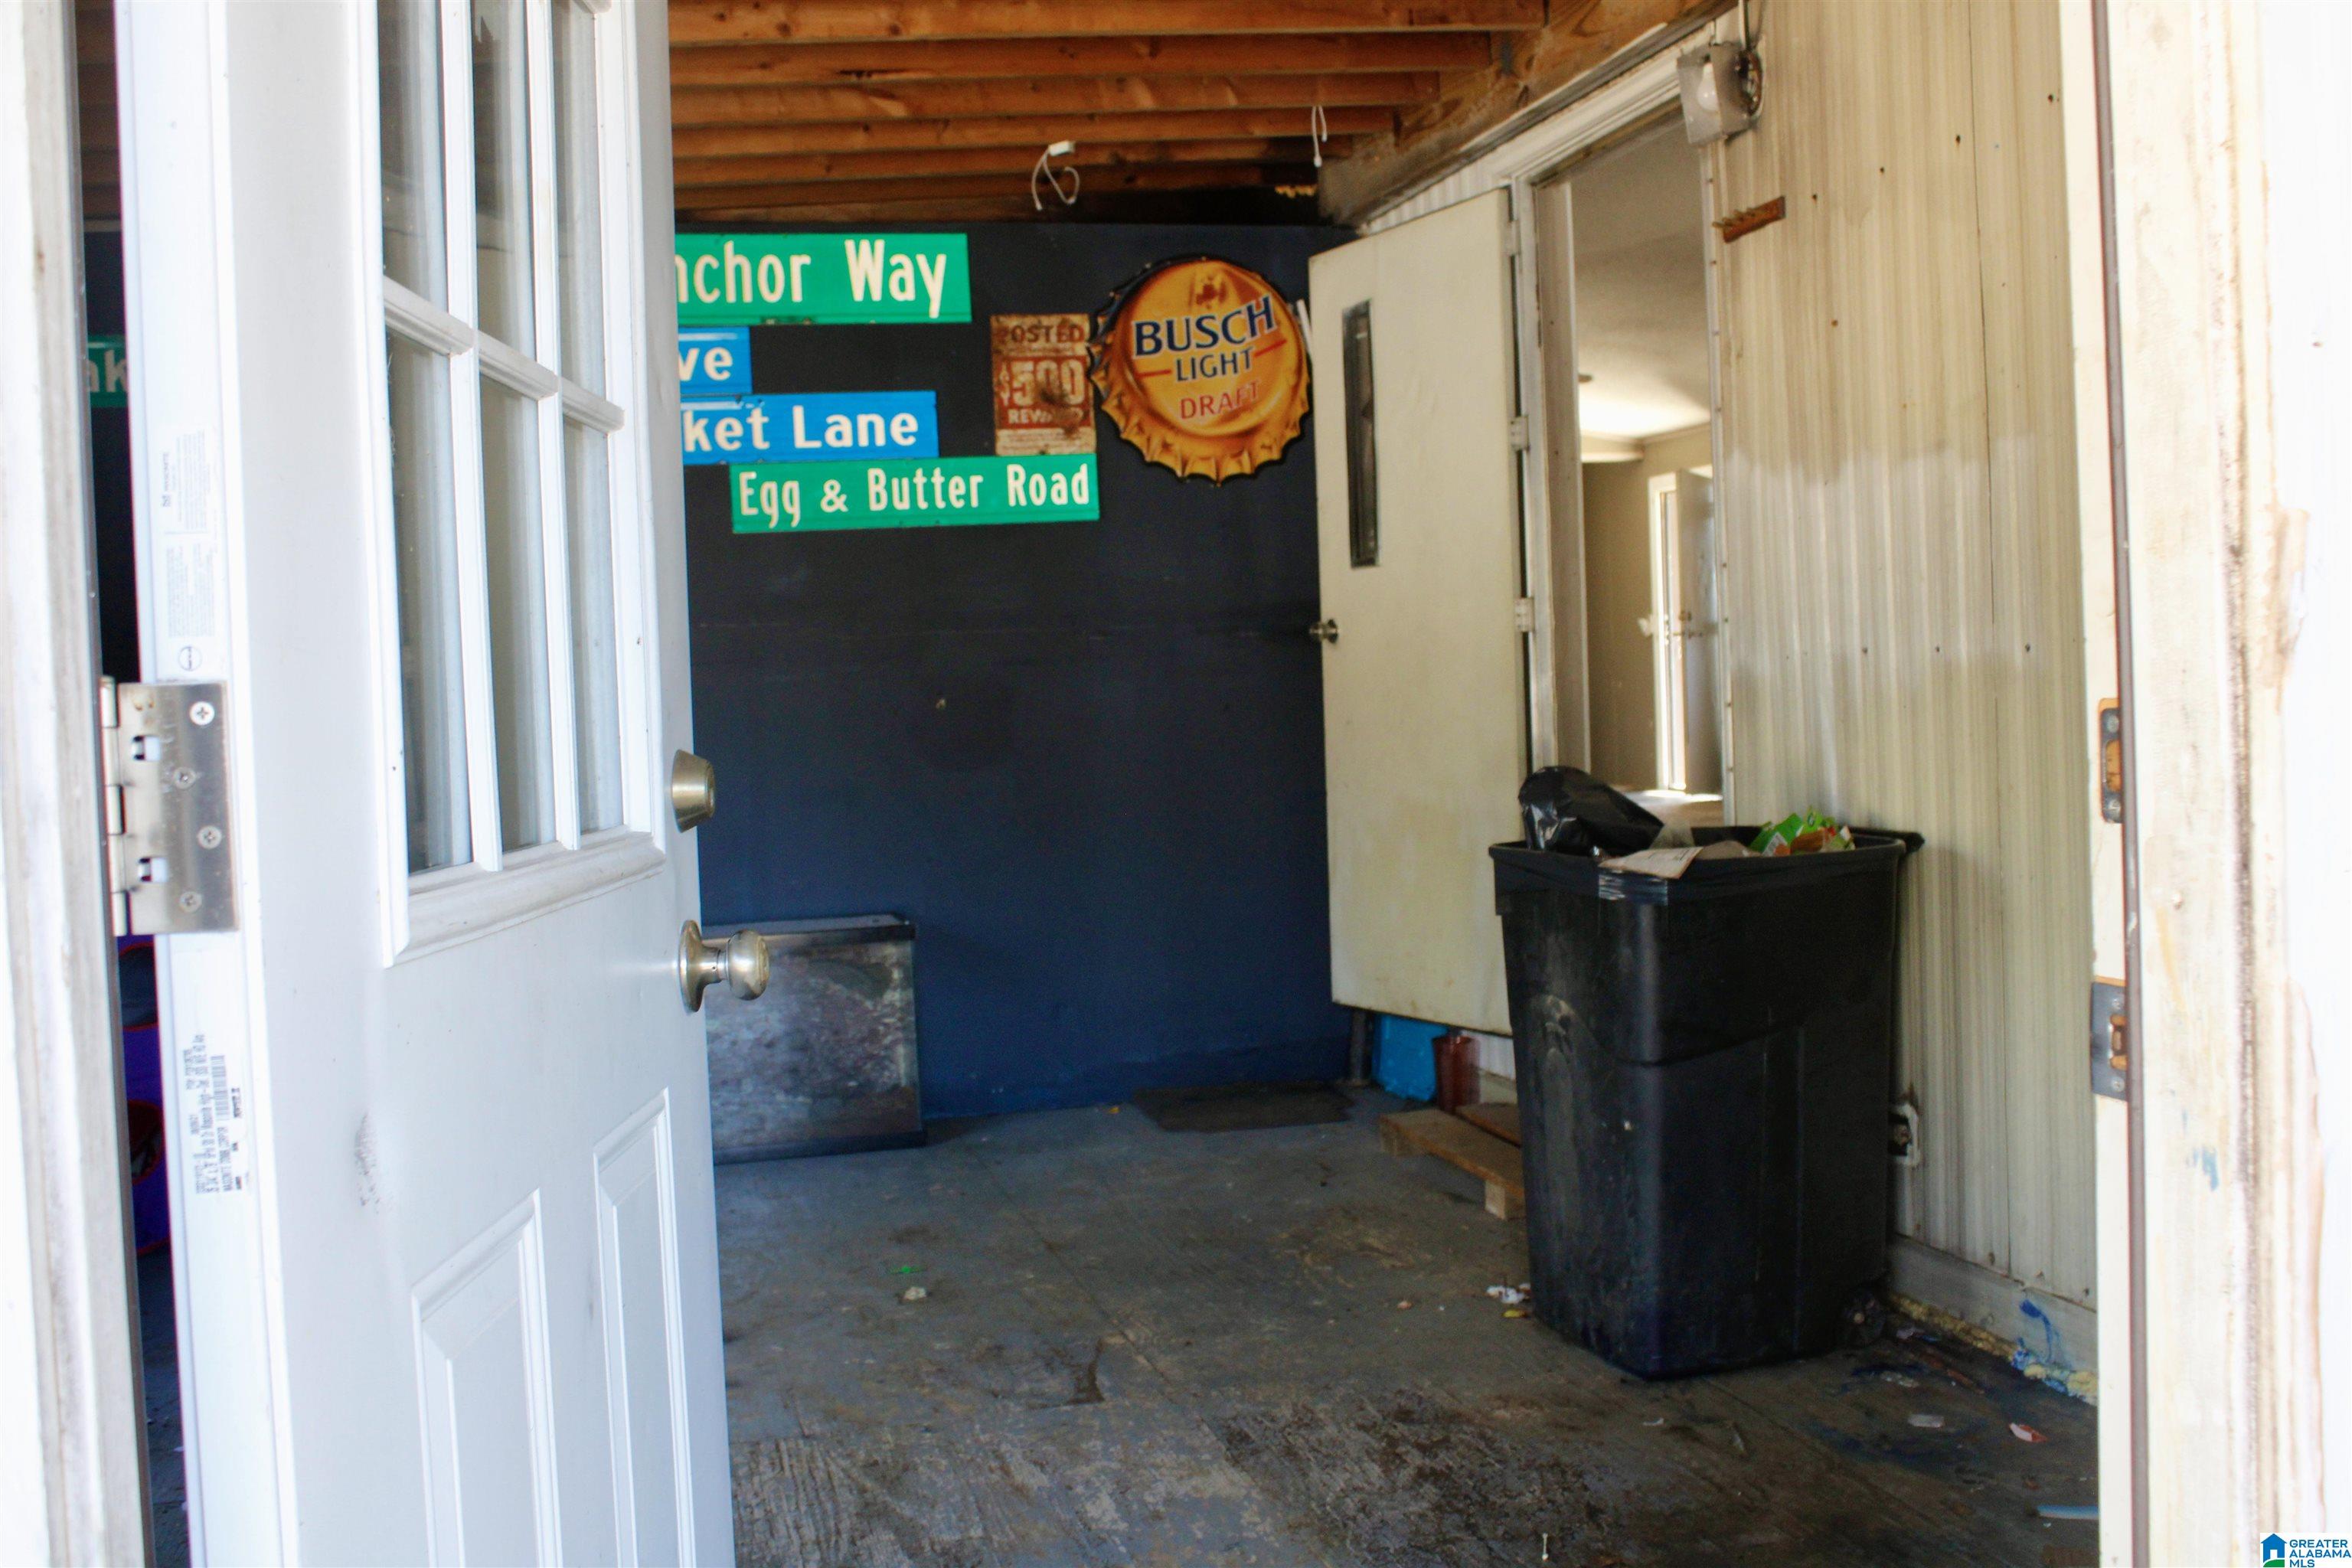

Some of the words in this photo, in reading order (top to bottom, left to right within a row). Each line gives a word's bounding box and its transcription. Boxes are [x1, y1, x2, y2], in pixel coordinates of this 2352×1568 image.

[844, 239, 946, 318] Way
[1134, 296, 1275, 357] BUSCH
[678, 346, 733, 381] ve
[998, 358, 1085, 407] $500
[1177, 347, 1253, 381] LIGHT
[1181, 381, 1259, 420] DRAFT
[683, 407, 770, 452] ket
[792, 405, 919, 448] Lane
[739, 472, 801, 528] Egg
[820, 479, 848, 512] &
[867, 467, 984, 511] Butter
[1007, 462, 1089, 506] Road
